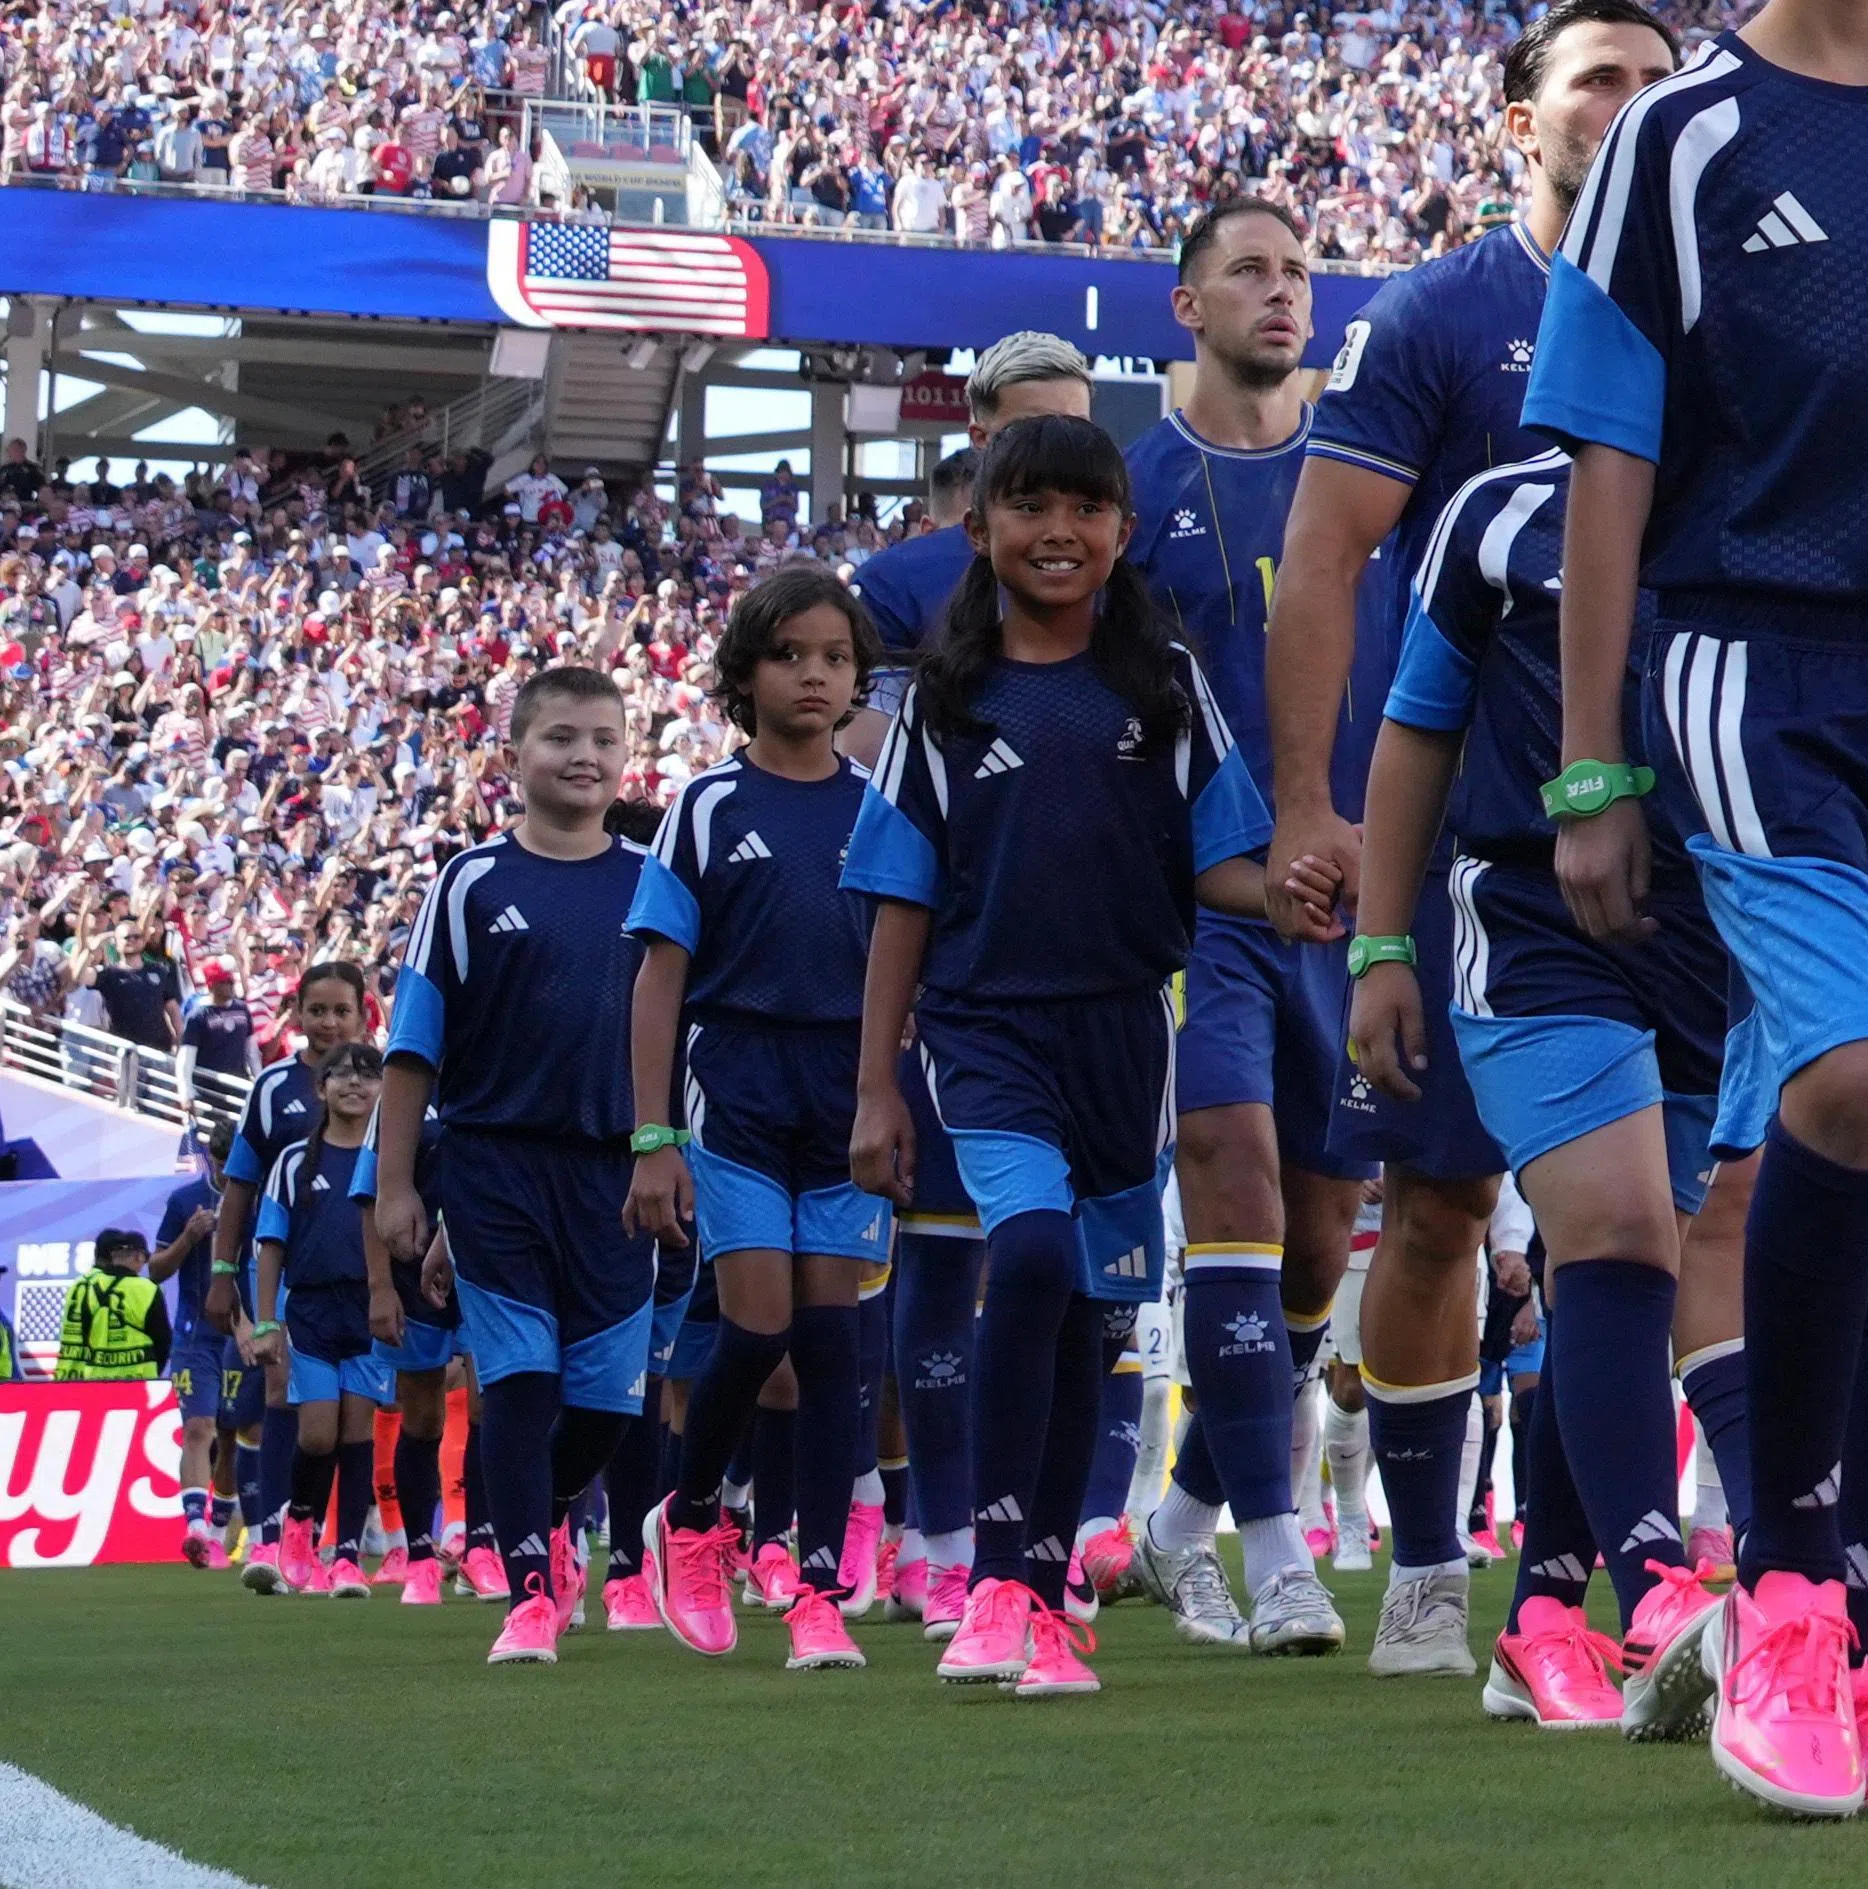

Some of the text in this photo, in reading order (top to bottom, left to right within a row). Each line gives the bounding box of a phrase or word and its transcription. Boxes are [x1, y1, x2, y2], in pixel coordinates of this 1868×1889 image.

[904, 387, 945, 406] 101
[1169, 526, 1207, 539] KELME
[1565, 774, 1605, 799] FIFA
[1339, 1097, 1377, 1113] KELME
[1218, 1340, 1276, 1357] KELME
[222, 1369, 242, 1398] 17
[914, 1373, 966, 1389] KELME
